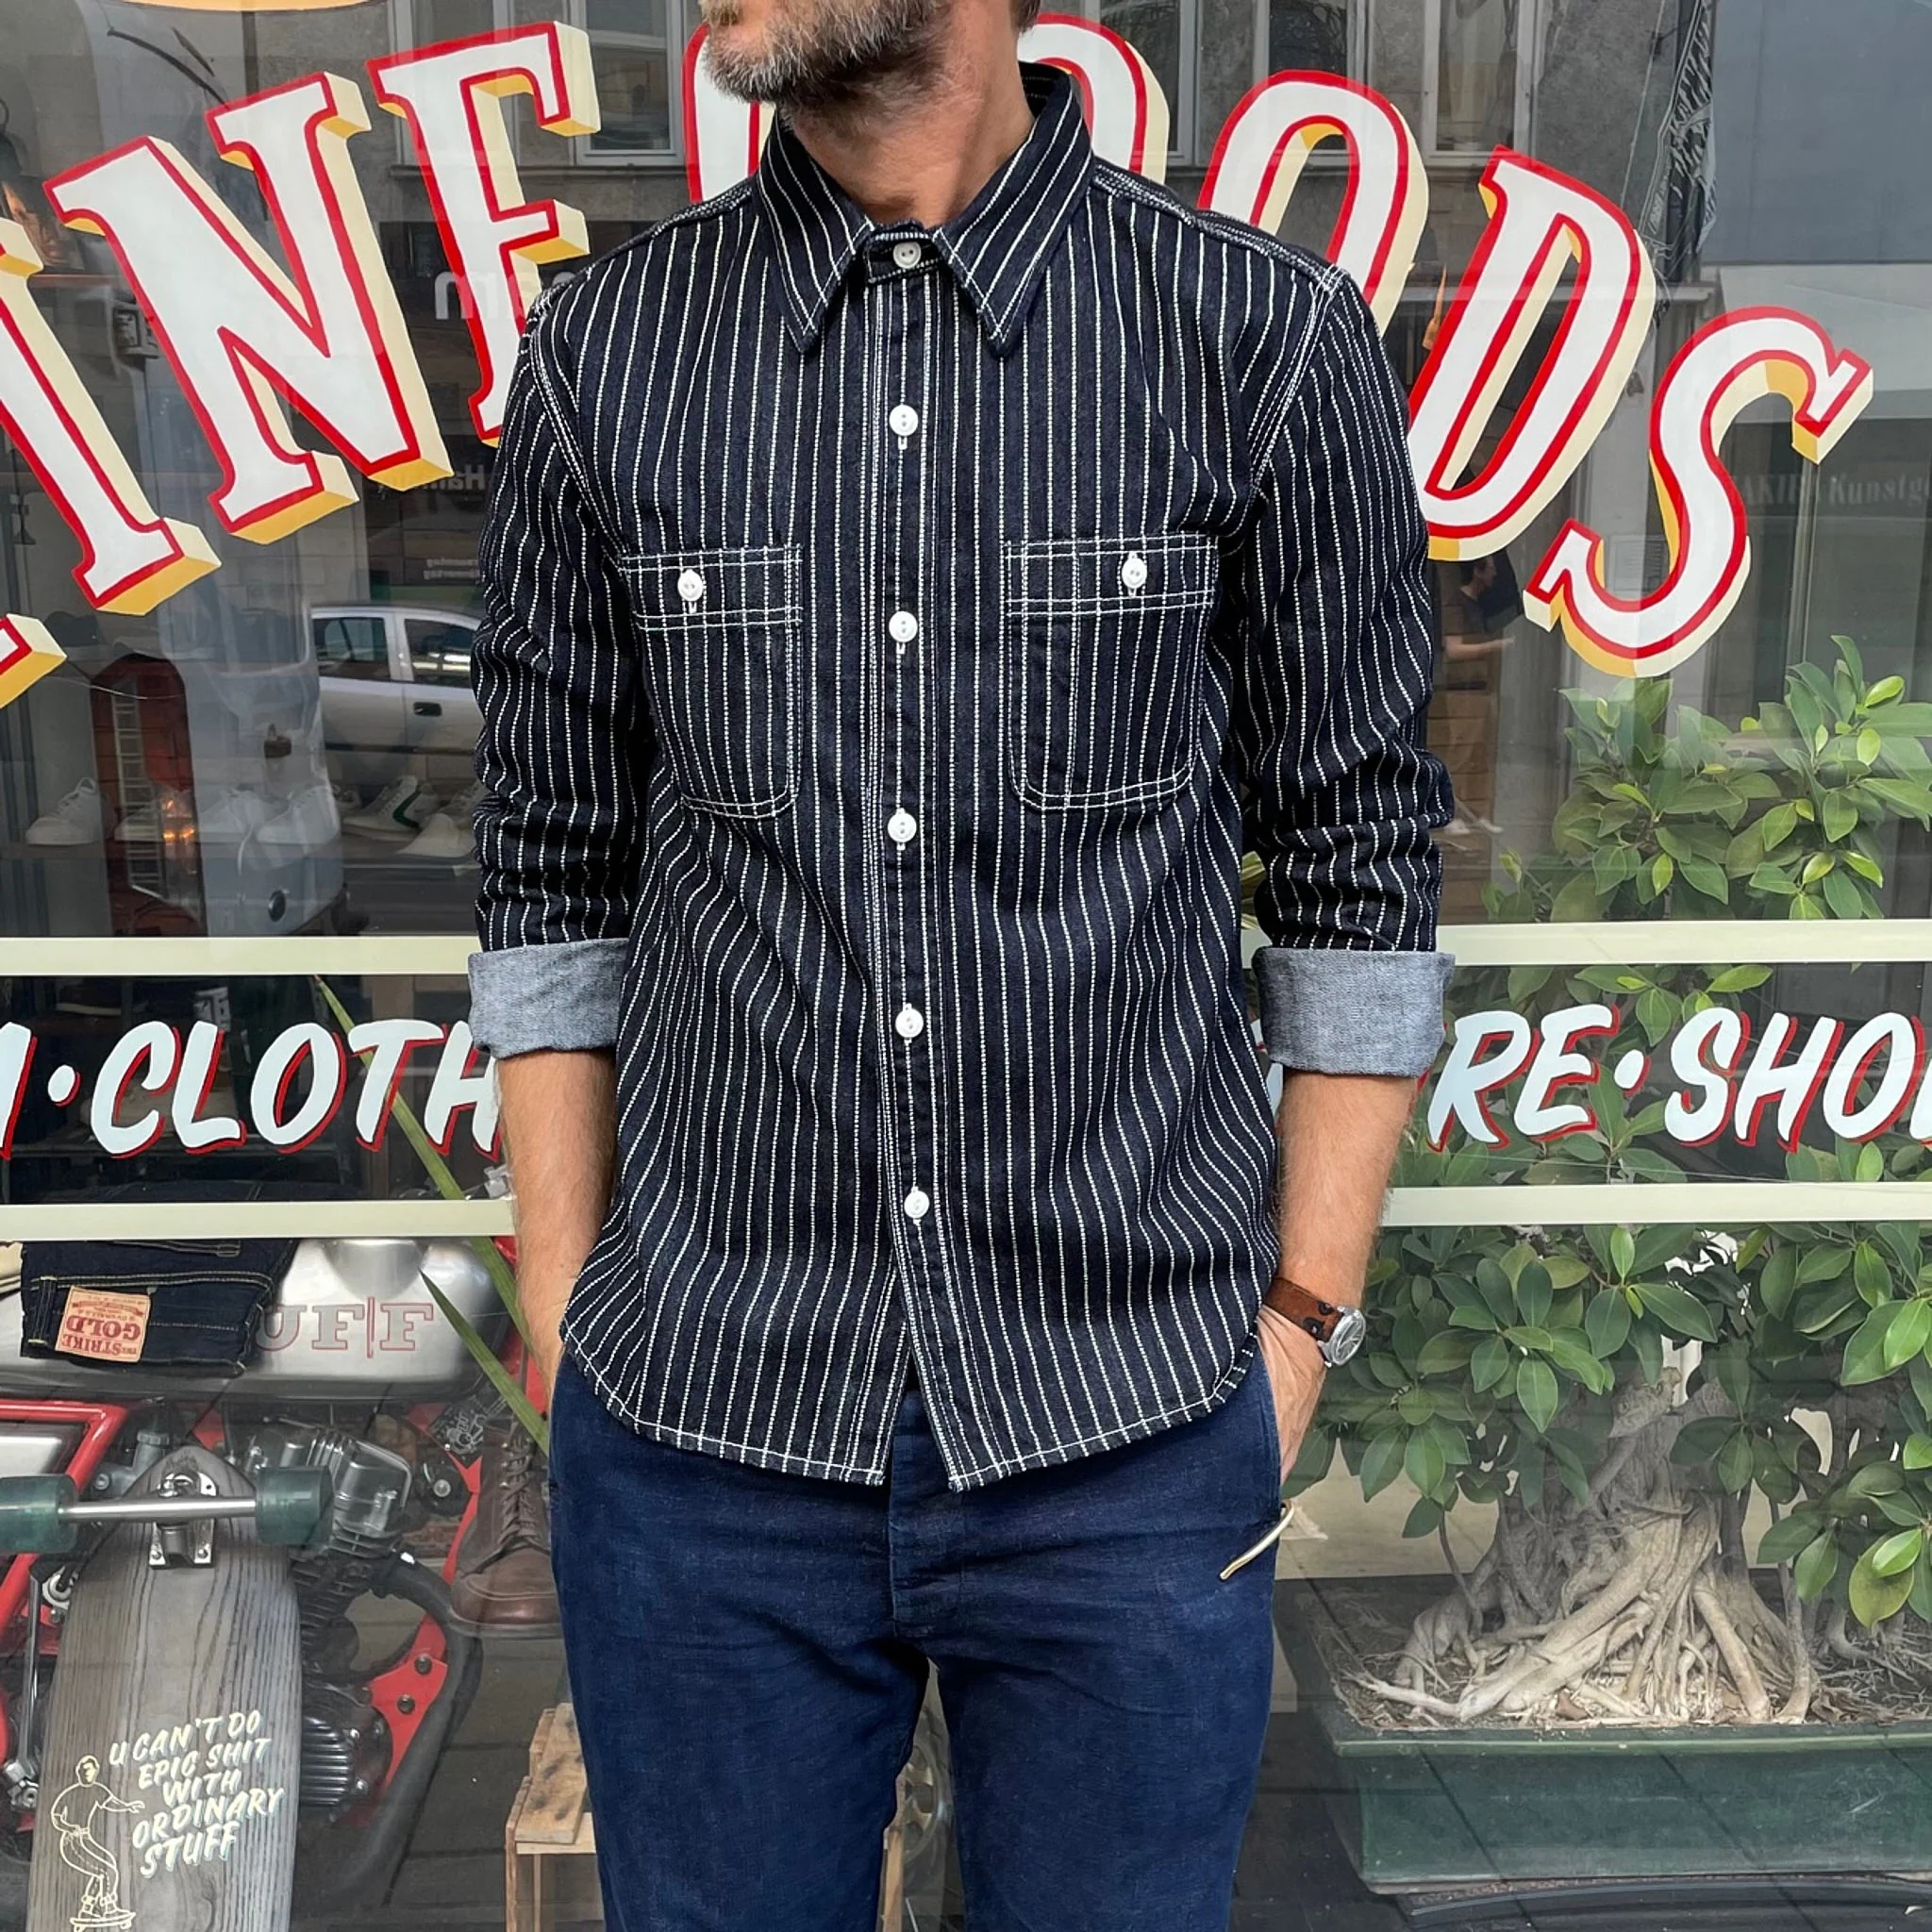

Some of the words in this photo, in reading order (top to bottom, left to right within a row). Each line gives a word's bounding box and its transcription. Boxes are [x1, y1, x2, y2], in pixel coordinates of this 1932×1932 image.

[91, 1021, 503, 1160] CLOTH
[1426, 1004, 1620, 1152] RE
[61, 1333, 122, 1356] STRIKE
[66, 1315, 142, 1341] GOLD
[109, 1740, 128, 1766] U
[133, 1716, 223, 1761] CAN'T
[227, 1709, 260, 1739] DO
[139, 1750, 198, 1790] EPIC
[206, 1738, 272, 1771] SHIT
[162, 1768, 242, 1807] WITH
[132, 1787, 285, 1849] ORDINARY
[141, 1821, 241, 1879] STUFF
